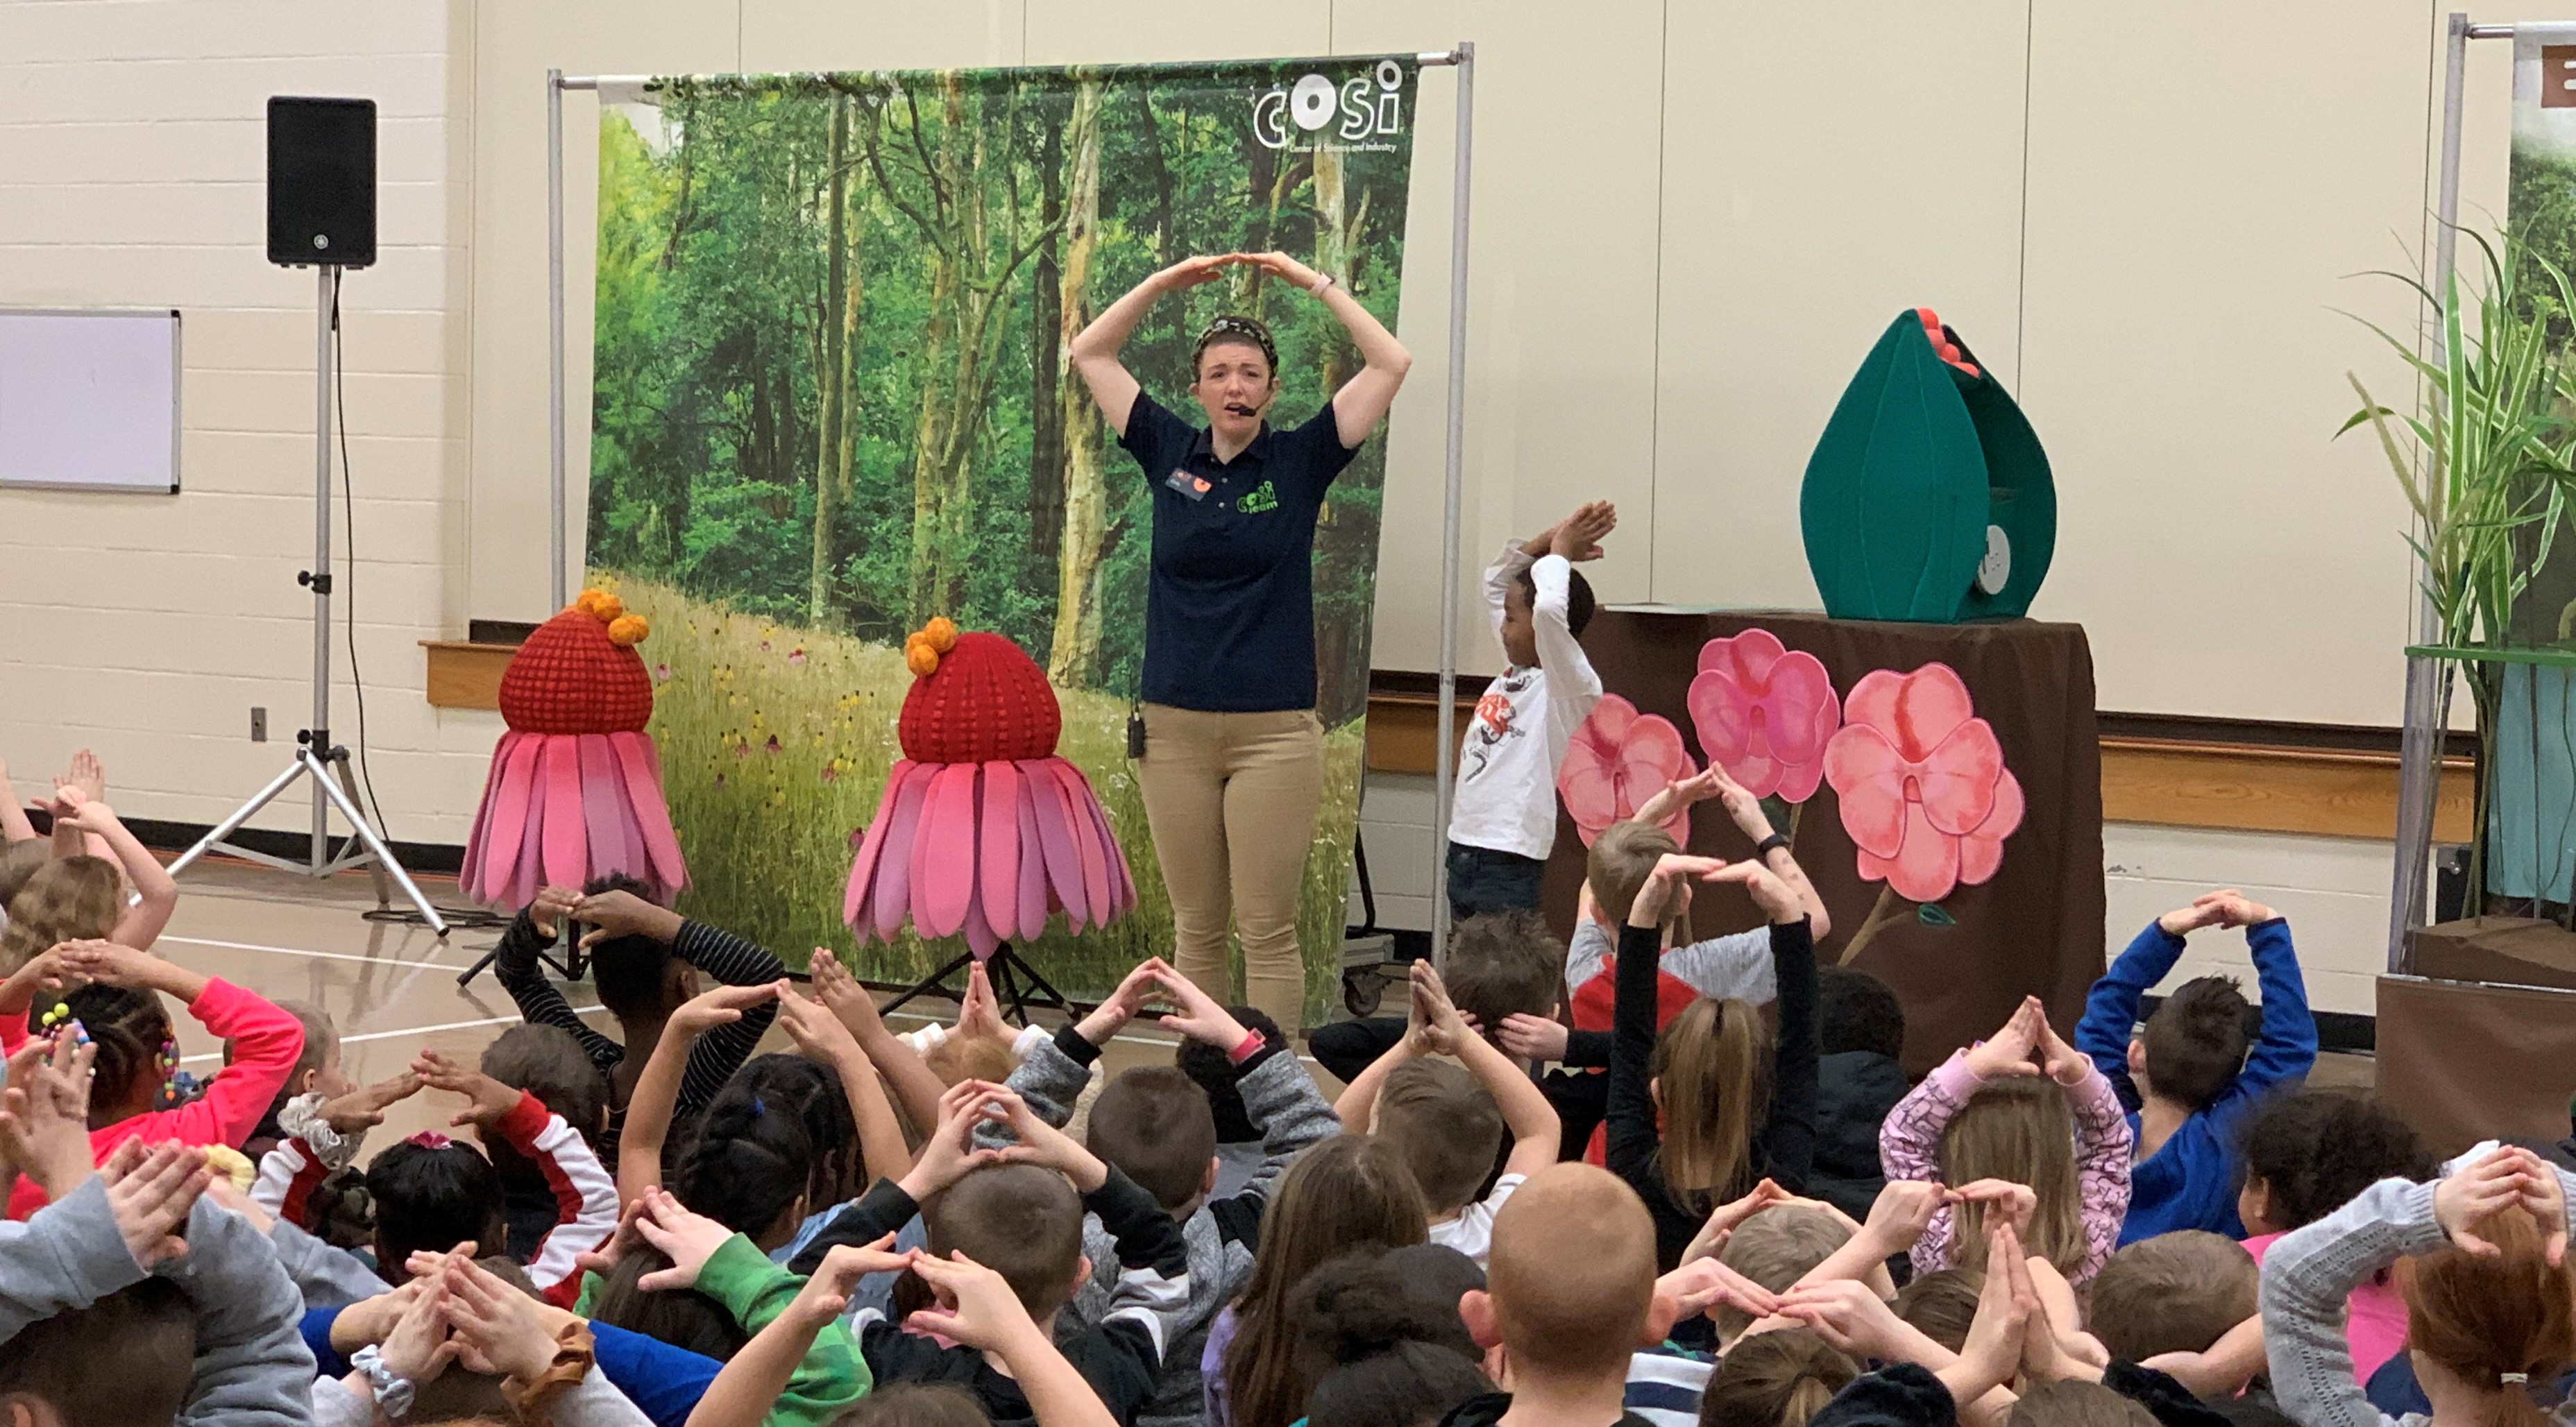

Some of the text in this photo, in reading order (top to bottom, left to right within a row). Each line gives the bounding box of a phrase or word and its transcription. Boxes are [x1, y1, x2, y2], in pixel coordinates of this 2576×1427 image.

[1289, 143, 1312, 153] Center
[1351, 141, 1365, 151] and
[1366, 142, 1397, 154] Industry
